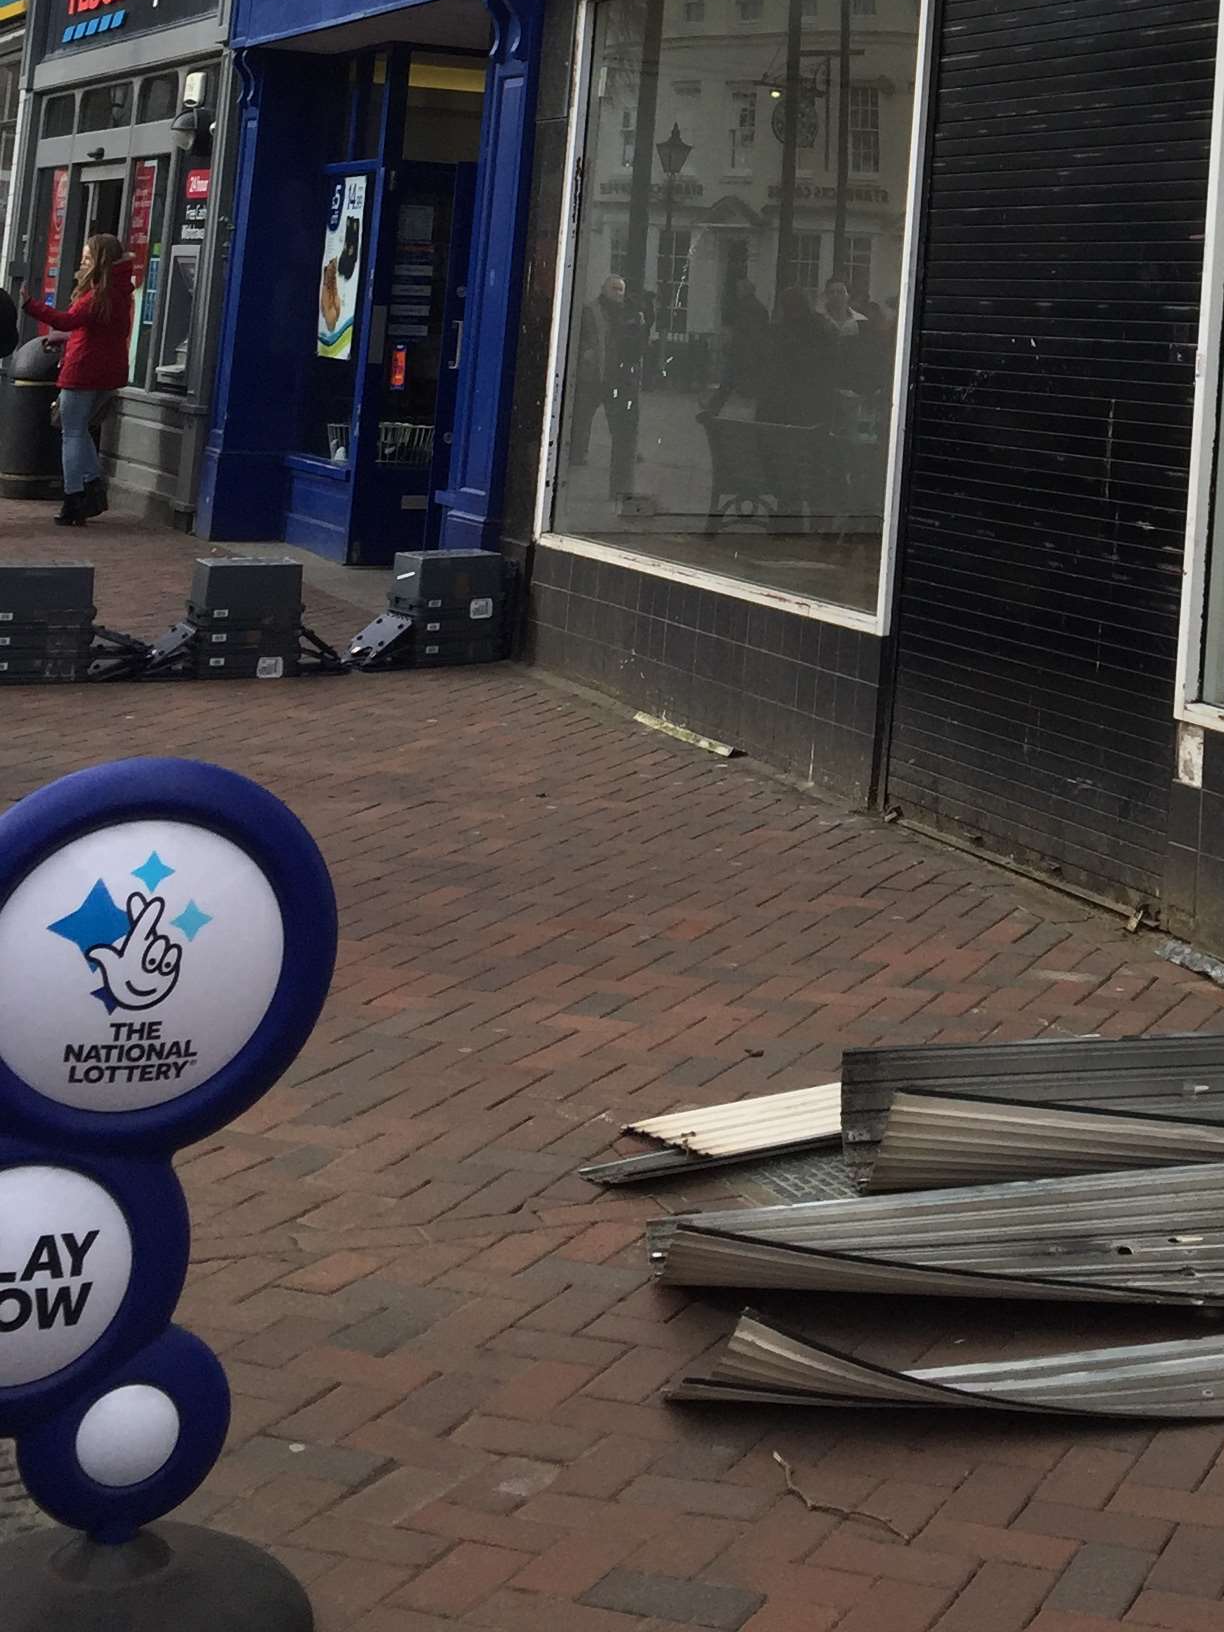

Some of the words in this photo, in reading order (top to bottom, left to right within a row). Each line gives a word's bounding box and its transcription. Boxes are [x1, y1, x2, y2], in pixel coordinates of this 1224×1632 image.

[109, 1021, 162, 1042] THE
[64, 1040, 198, 1064] NATIONAL
[67, 1060, 189, 1084] LOTTERY
[0, 1280, 93, 1333] OW
